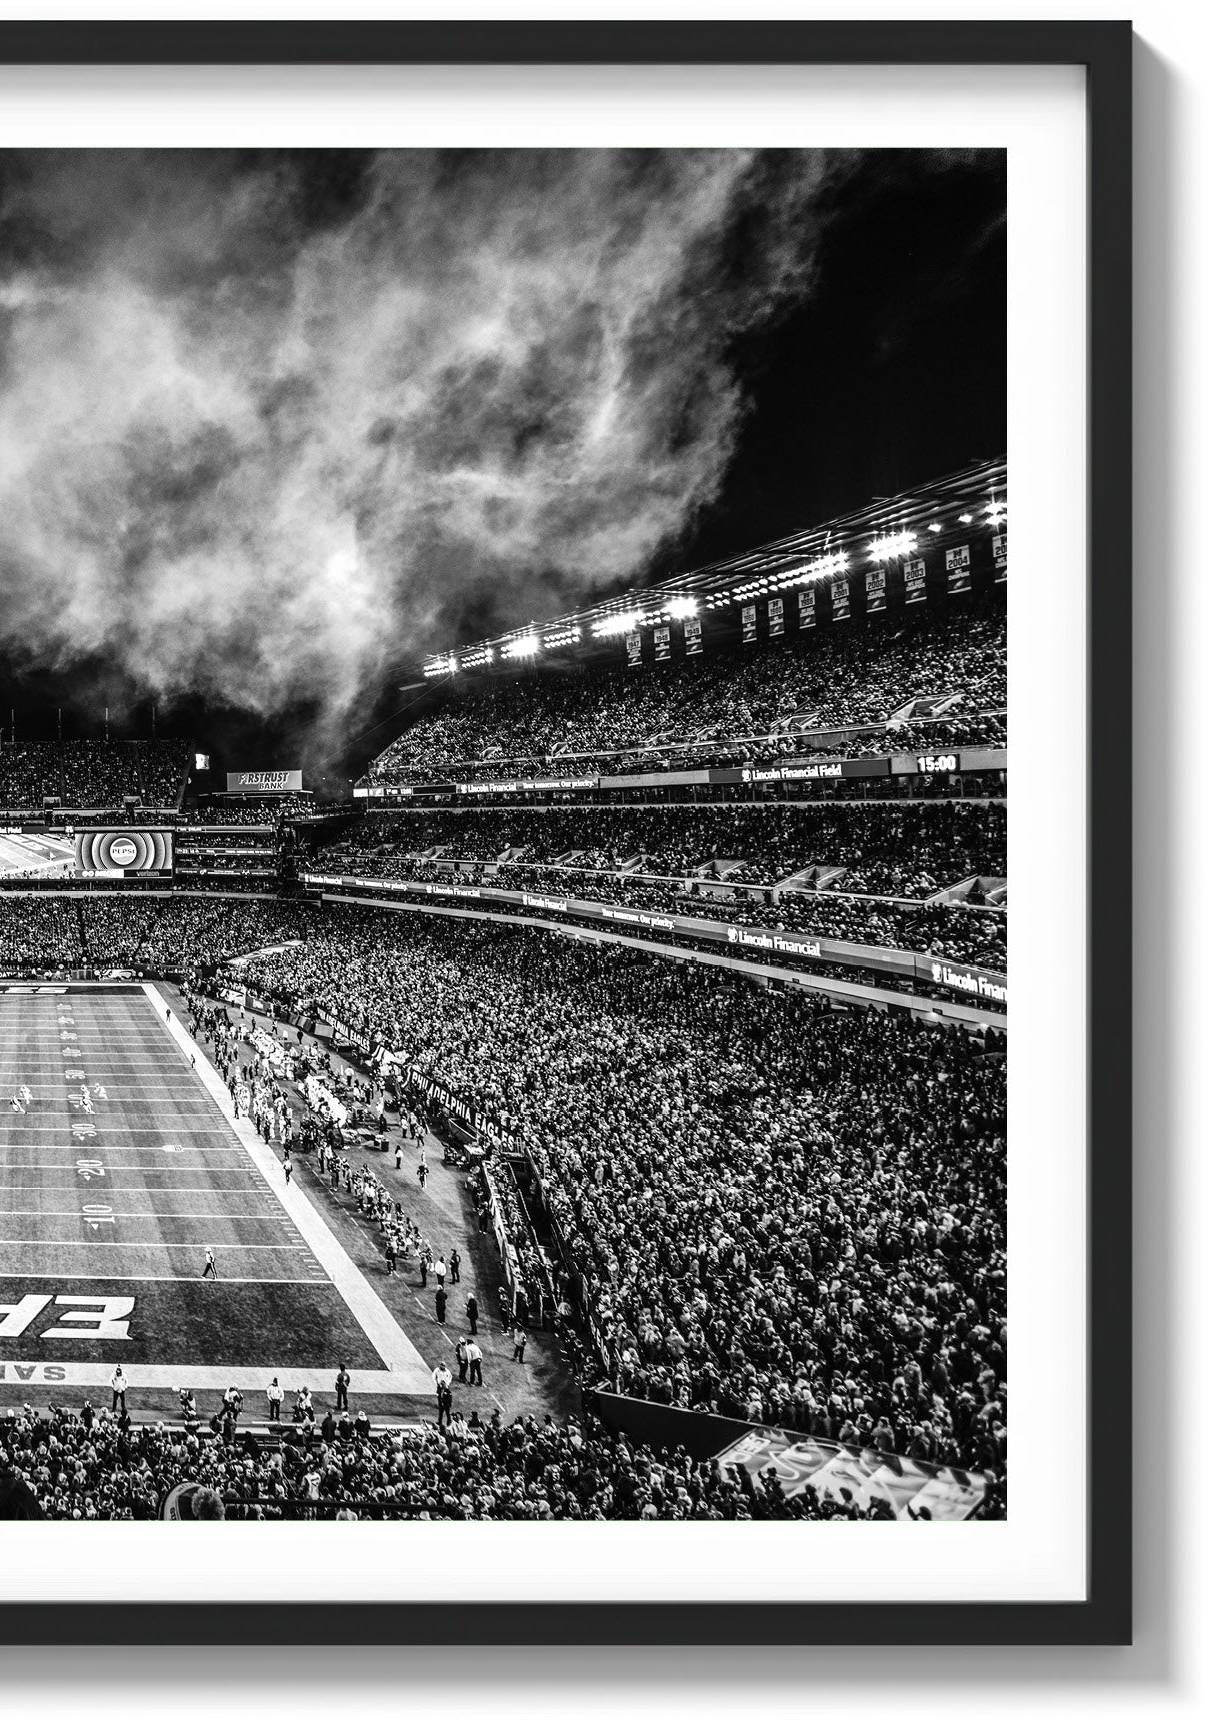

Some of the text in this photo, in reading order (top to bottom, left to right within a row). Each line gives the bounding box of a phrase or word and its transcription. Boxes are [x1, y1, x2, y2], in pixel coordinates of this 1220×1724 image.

[948, 555, 968, 568] 2004
[906, 567, 923, 580] 2003
[867, 579, 884, 590] 2002
[918, 755, 956, 772] 15:00
[753, 763, 842, 781] Lincoln Financial Field
[260, 782, 283, 790] BANK
[468, 783, 516, 793] Lincoln Financial
[7, 826, 22, 834] Field
[433, 885, 480, 898] Lincoln Financial
[738, 930, 821, 957] Lincoln Financial
[942, 967, 978, 993] Lincoln
[410, 1070, 472, 1123] PHILADELPHIA
[71, 1123, 98, 1137] 30
[76, 1159, 106, 1176] 20
[82, 1204, 116, 1224] 10
